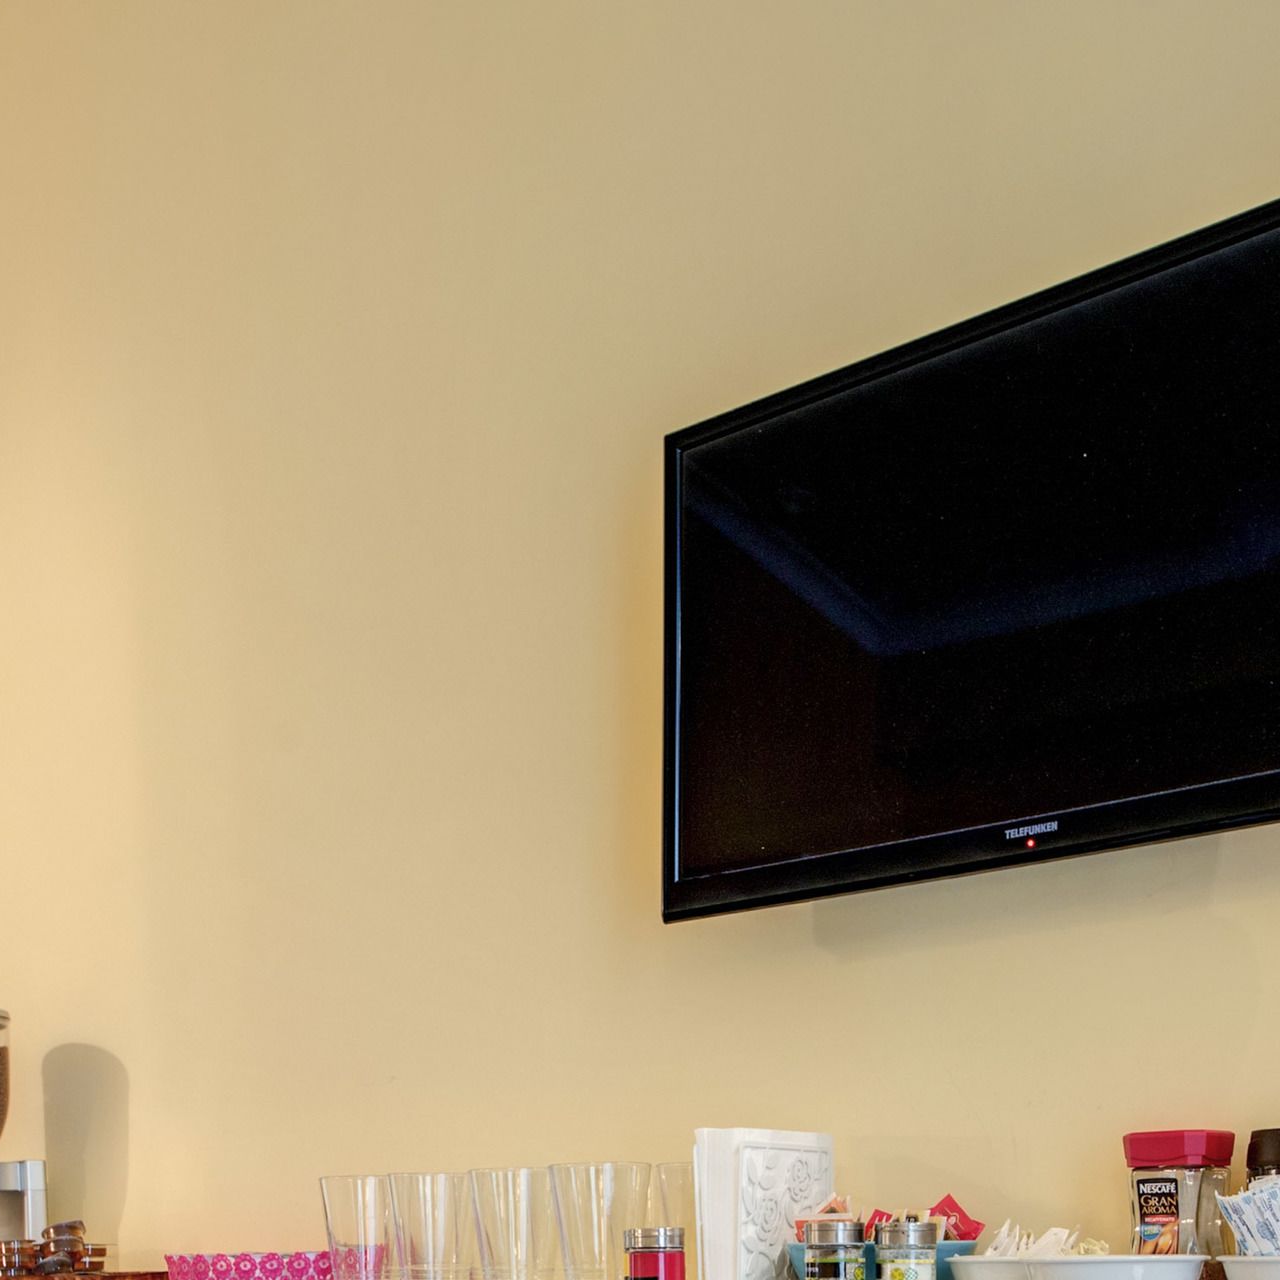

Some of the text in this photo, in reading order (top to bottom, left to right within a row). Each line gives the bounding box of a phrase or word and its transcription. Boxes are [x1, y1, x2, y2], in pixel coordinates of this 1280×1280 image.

[1005, 821, 1058, 840] TELEFUNKEN
[1139, 1182, 1177, 1194] NESCAFÉ
[1140, 1194, 1177, 1207] GRAN
[1141, 1206, 1177, 1214] AROMA
